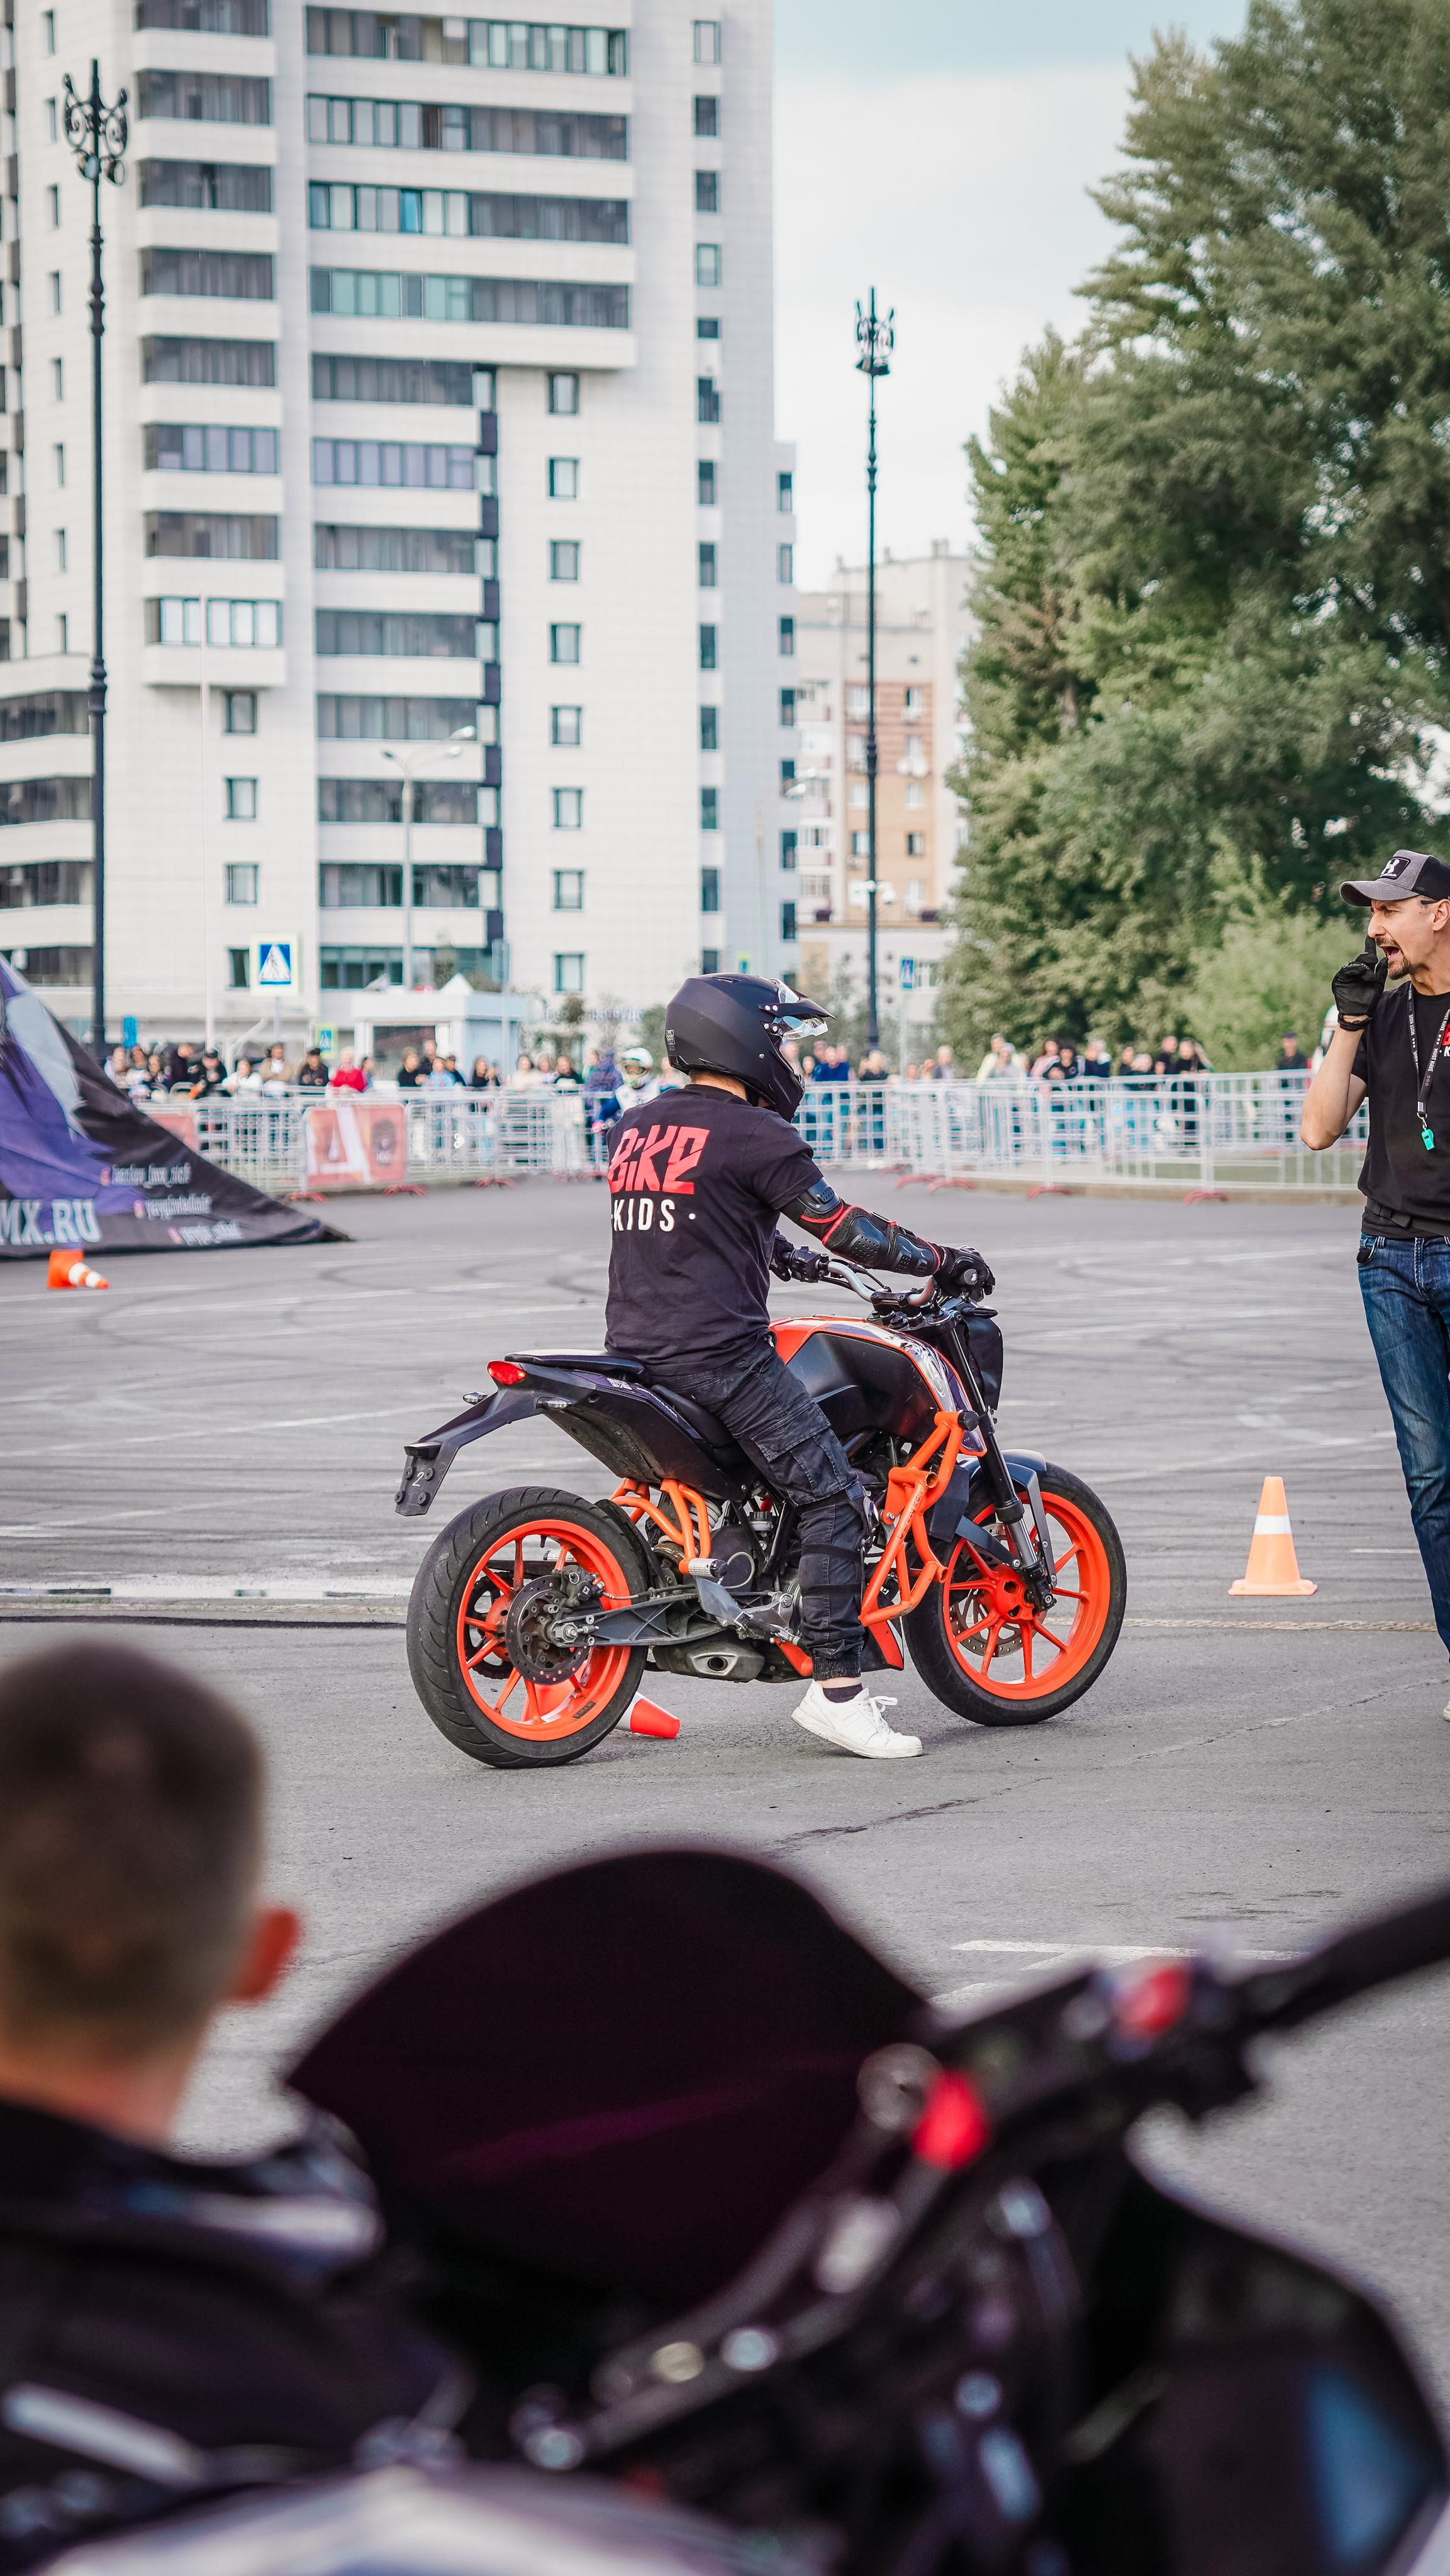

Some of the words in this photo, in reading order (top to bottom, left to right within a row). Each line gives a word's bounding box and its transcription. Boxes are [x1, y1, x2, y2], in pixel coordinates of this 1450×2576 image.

[607, 1124, 710, 1195] BIKE
[613, 1198, 675, 1232] KIDS
[412, 1472, 425, 1487] 2
